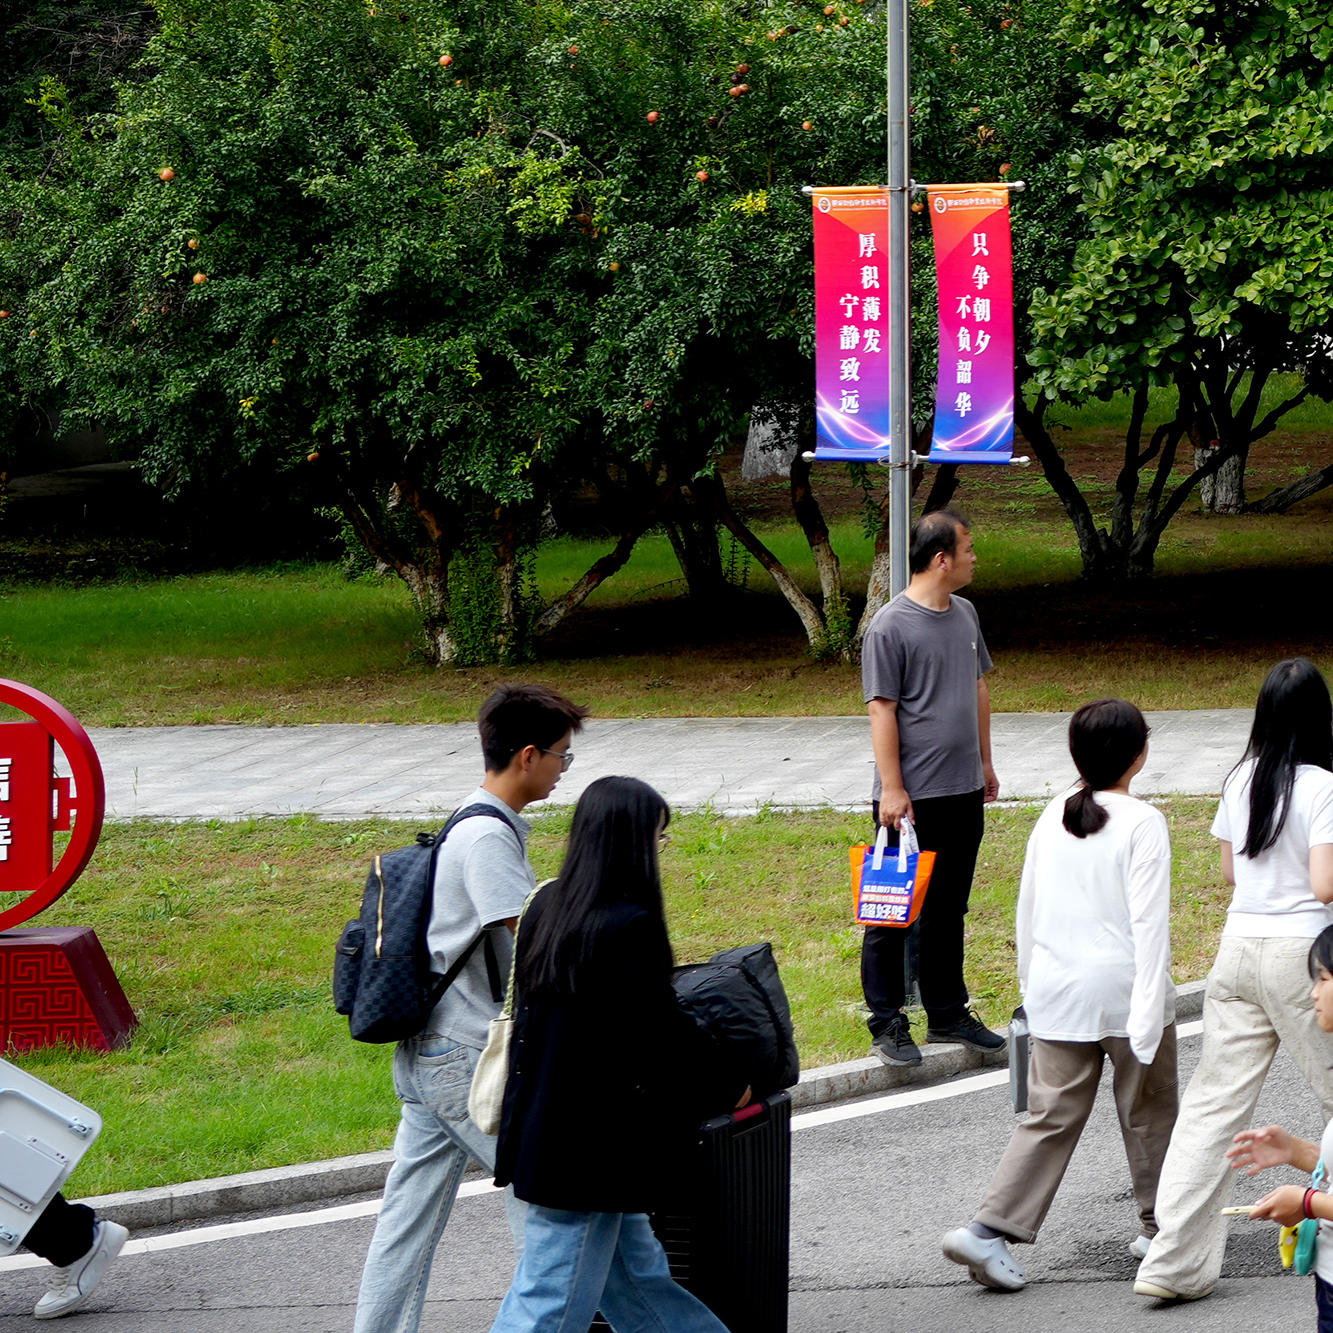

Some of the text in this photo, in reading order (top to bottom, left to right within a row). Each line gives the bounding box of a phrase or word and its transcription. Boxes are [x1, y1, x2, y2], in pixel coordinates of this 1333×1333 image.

[859, 232, 882, 353] 厚积薄发
[971, 232, 991, 356] 只争朝夕
[839, 293, 861, 415] 宁静致远
[954, 294, 972, 418] 不负韶华
[860, 903, 908, 921] 超好吃
